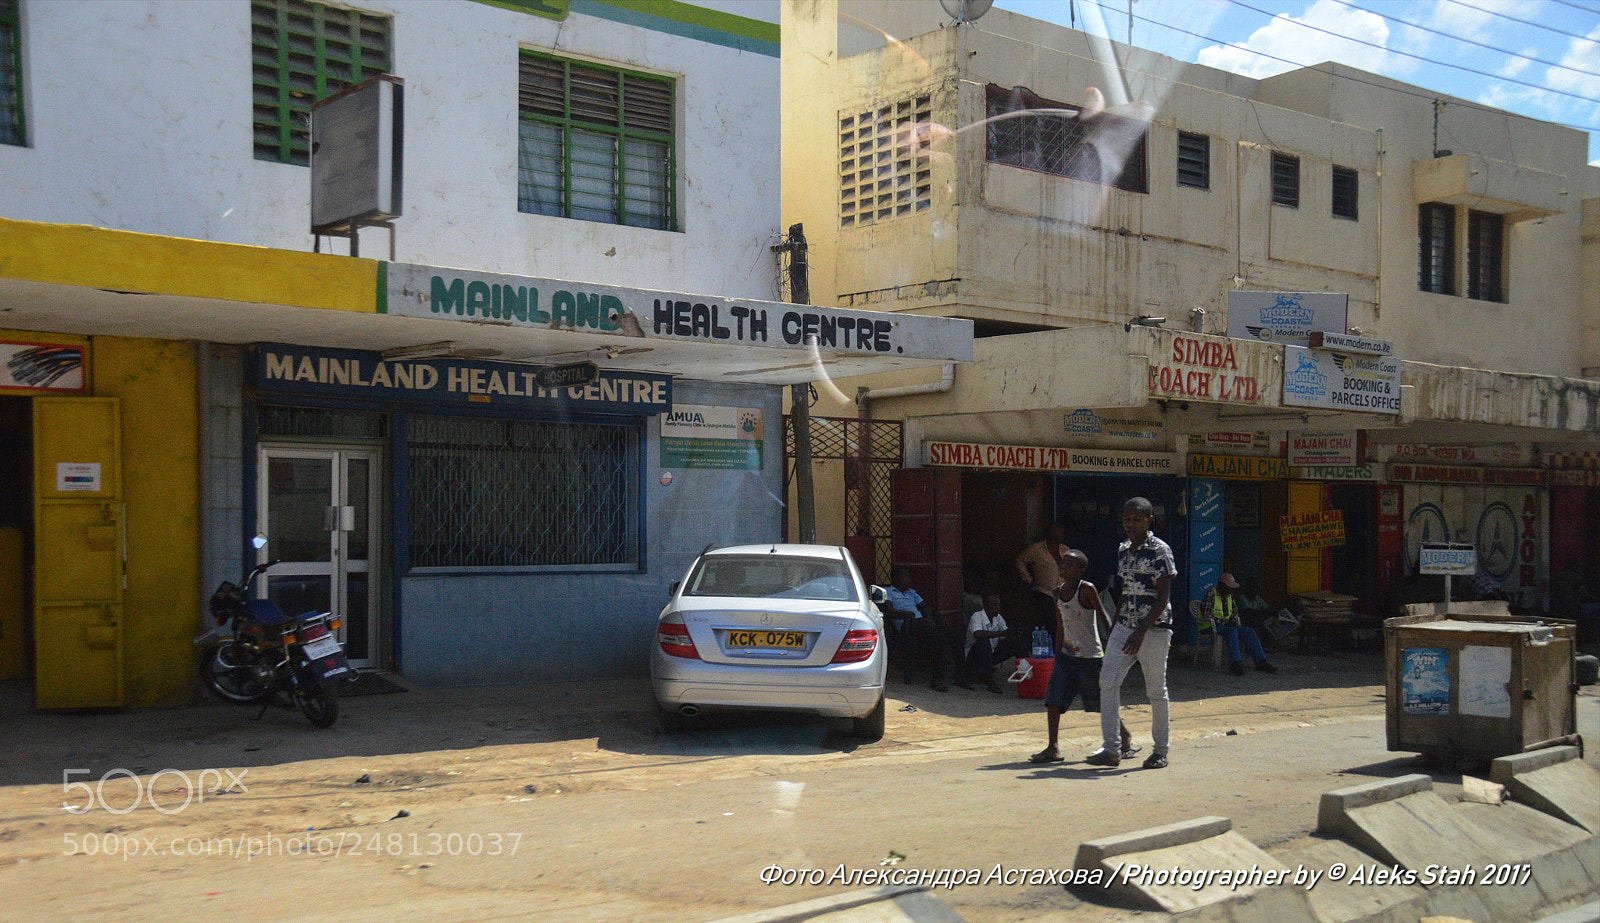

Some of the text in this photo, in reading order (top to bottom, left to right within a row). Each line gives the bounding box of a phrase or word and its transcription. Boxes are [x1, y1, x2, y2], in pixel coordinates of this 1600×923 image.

[430, 275, 904, 355] MAINLAND HEALTH CENTRE.
[1260, 307, 1314, 321] MODERN
[1271, 317, 1303, 325] COAST
[1275, 329, 1304, 337] Modern
[1325, 334, 1391, 354] www.modern.co.ke
[1173, 336, 1238, 371] SIMBA
[265, 352, 438, 390] MAINLAND
[1355, 359, 1397, 373] Modern Coast
[543, 367, 586, 384] HOSPITAL
[1294, 385, 1319, 395] COAST
[1343, 377, 1391, 394] BOOKING &
[1331, 391, 1400, 410] PARCELS OFFICE
[666, 412, 701, 422] AMUA
[1293, 438, 1351, 449] MAJANI CHAI
[930, 442, 1171, 470] SIMBA COACH LTD. BOOKING & PARCEL OFFICE
[1192, 455, 1254, 476] MAJANI
[1280, 511, 1321, 527] MAJANI
[1281, 522, 1343, 536] CHANGAMWE
[1420, 551, 1476, 566] MODERN
[729, 632, 804, 646] KCK 075W
